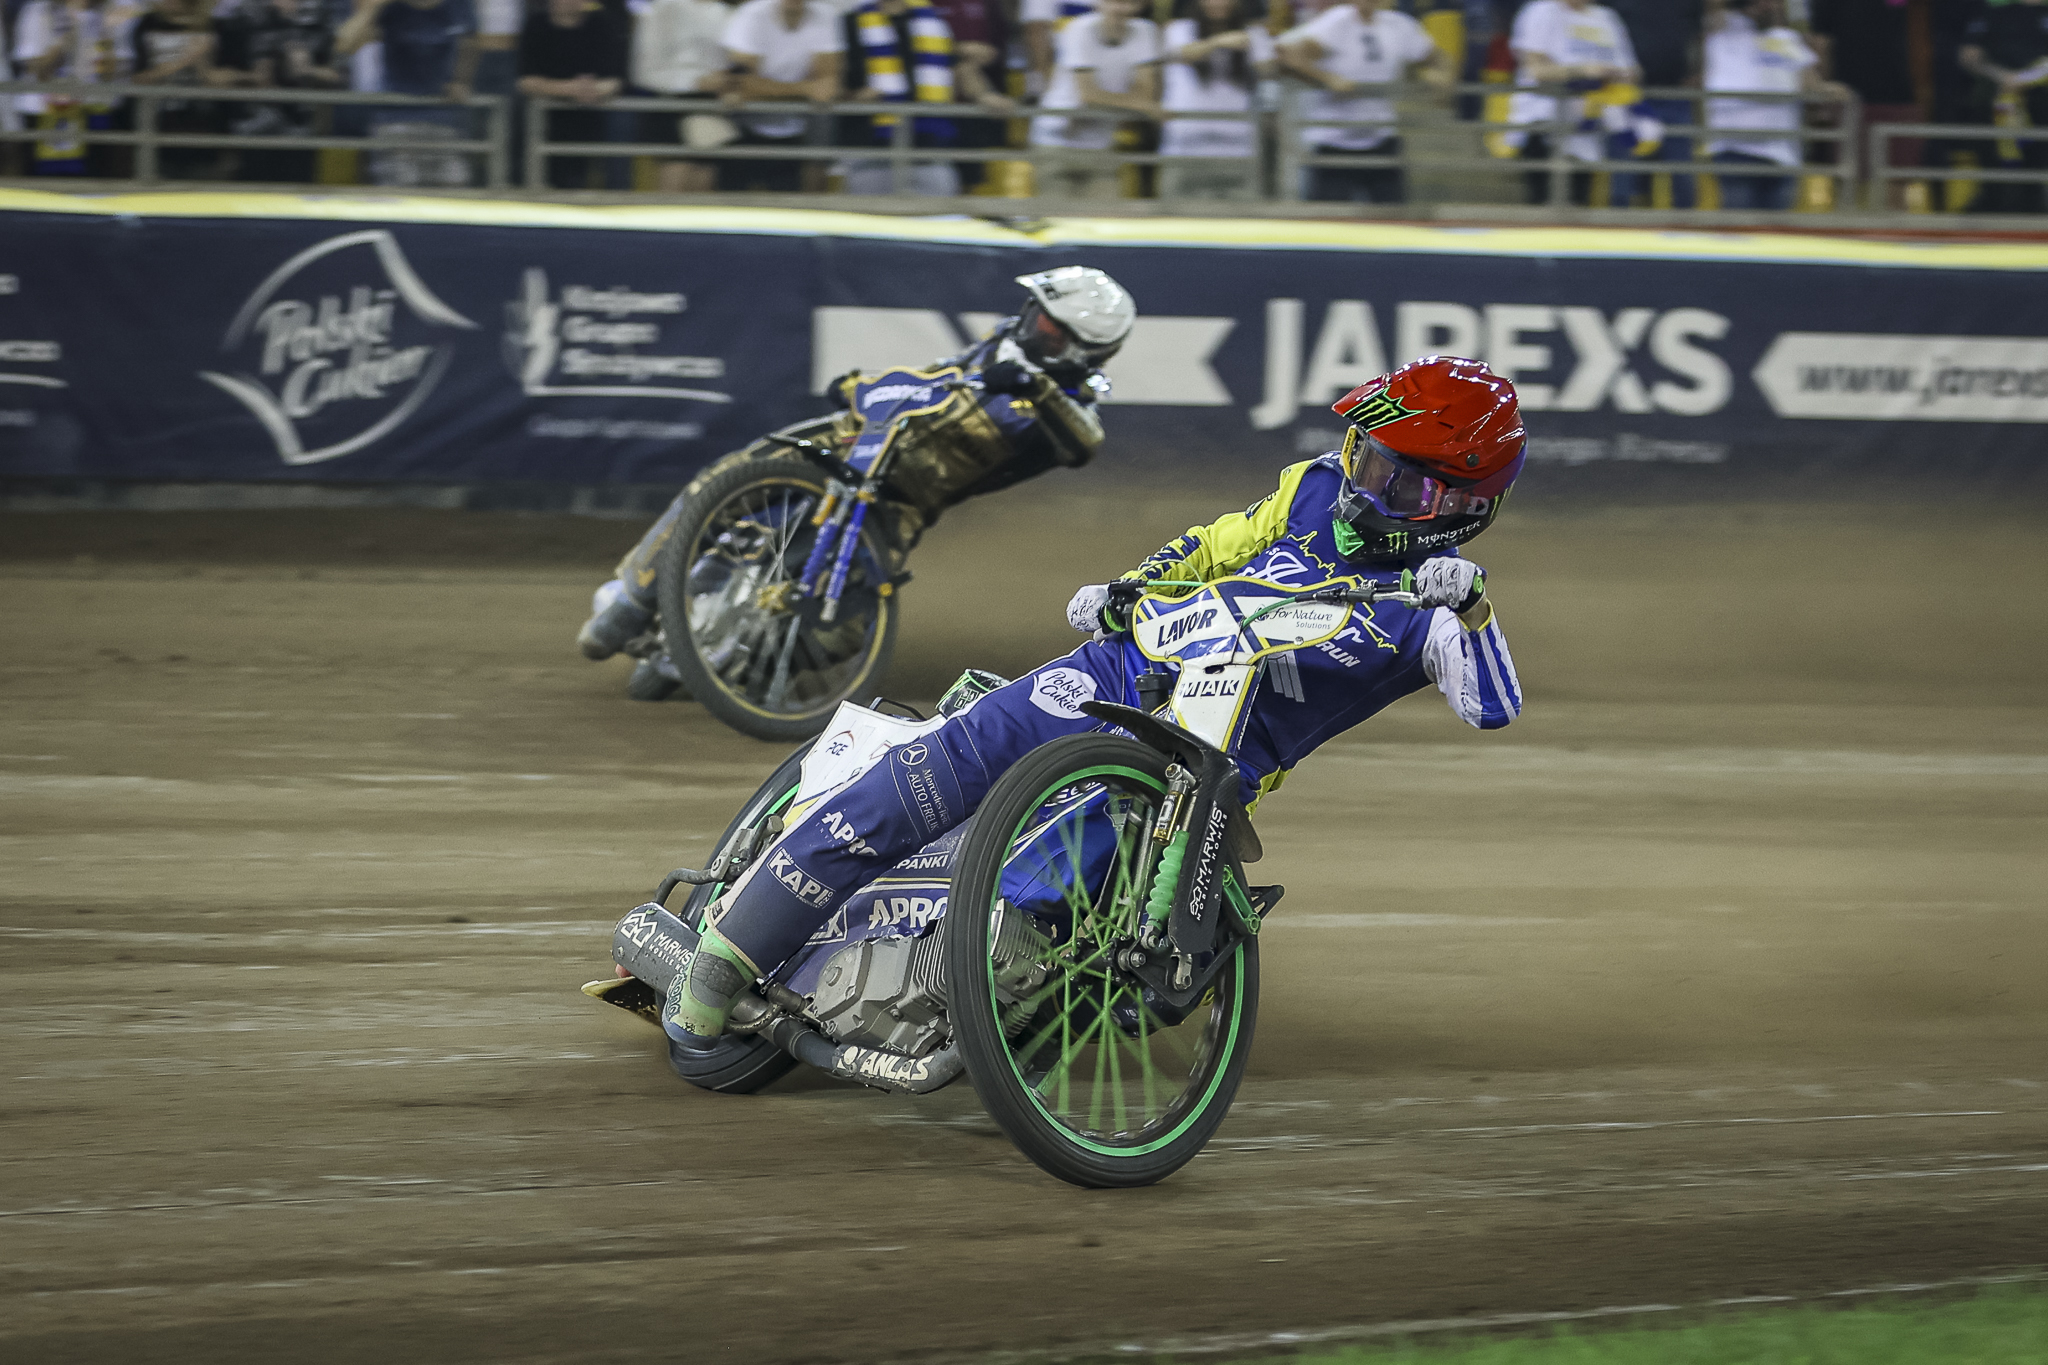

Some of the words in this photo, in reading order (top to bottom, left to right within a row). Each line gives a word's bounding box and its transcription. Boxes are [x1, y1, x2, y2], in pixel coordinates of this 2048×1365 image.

[1417, 520, 1481, 545] MONSTER
[1157, 608, 1218, 648] LAVOR
[1269, 607, 1292, 619] for
[1292, 609, 1333, 621] Nature
[1295, 621, 1331, 630] Solutions
[1040, 685, 1080, 713] Cukier
[1044, 671, 1087, 699] Polski
[909, 774, 928, 802] AUTO
[1197, 807, 1222, 886] MARWIS
[893, 855, 949, 869] PANKI
[1197, 868, 1212, 921] MOBILE
[1212, 814, 1228, 860] HOMES
[770, 851, 829, 904] KAPI
[654, 932, 694, 965] MARWIS
[860, 1051, 934, 1080] ANLAS
